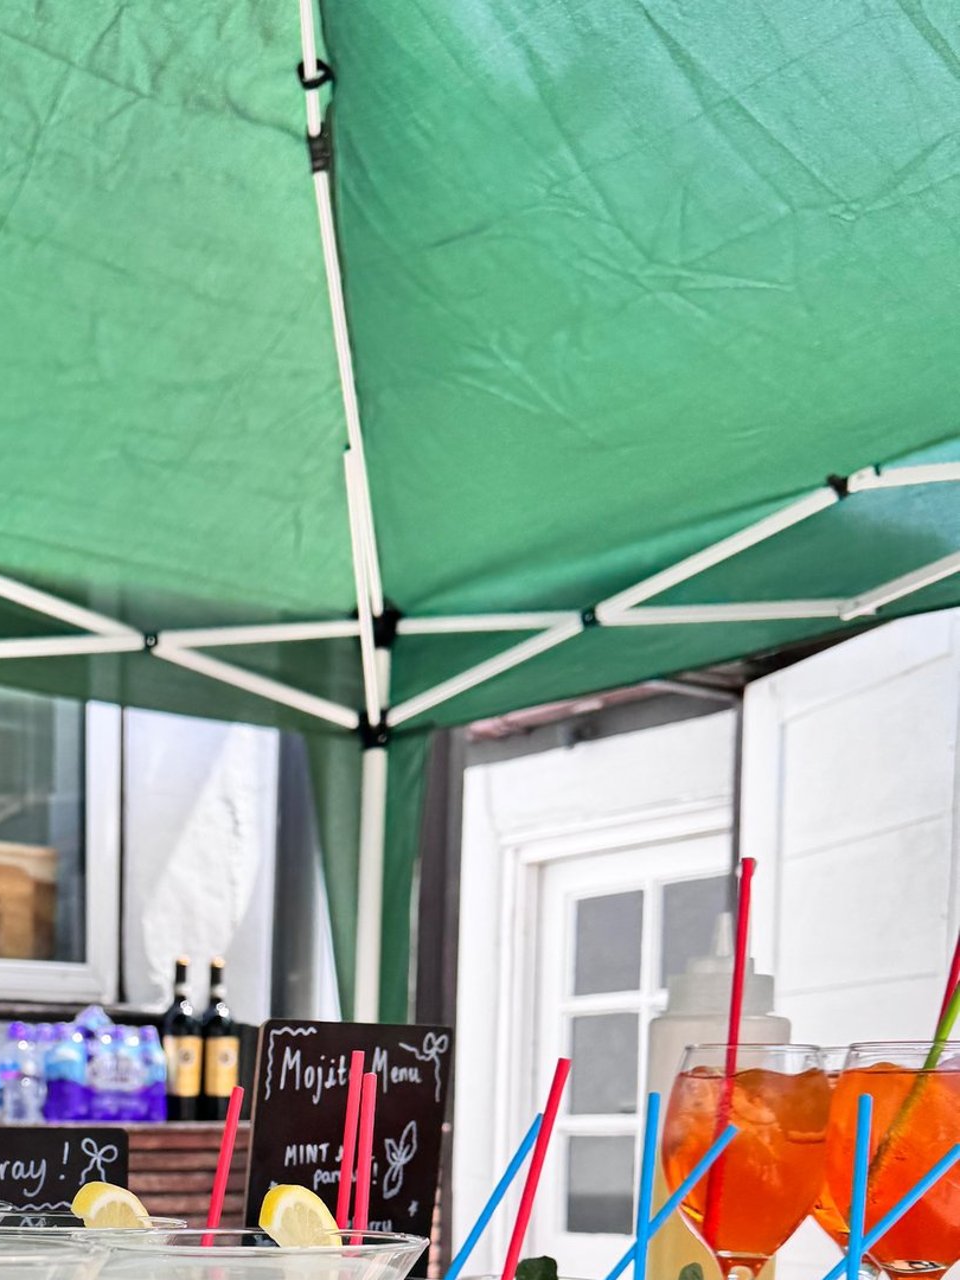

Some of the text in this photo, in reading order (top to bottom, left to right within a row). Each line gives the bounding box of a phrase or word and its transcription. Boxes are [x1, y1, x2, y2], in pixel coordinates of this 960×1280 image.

[279, 1046, 423, 1105] Mojit Menu
[283, 1142, 331, 1168] MINT
